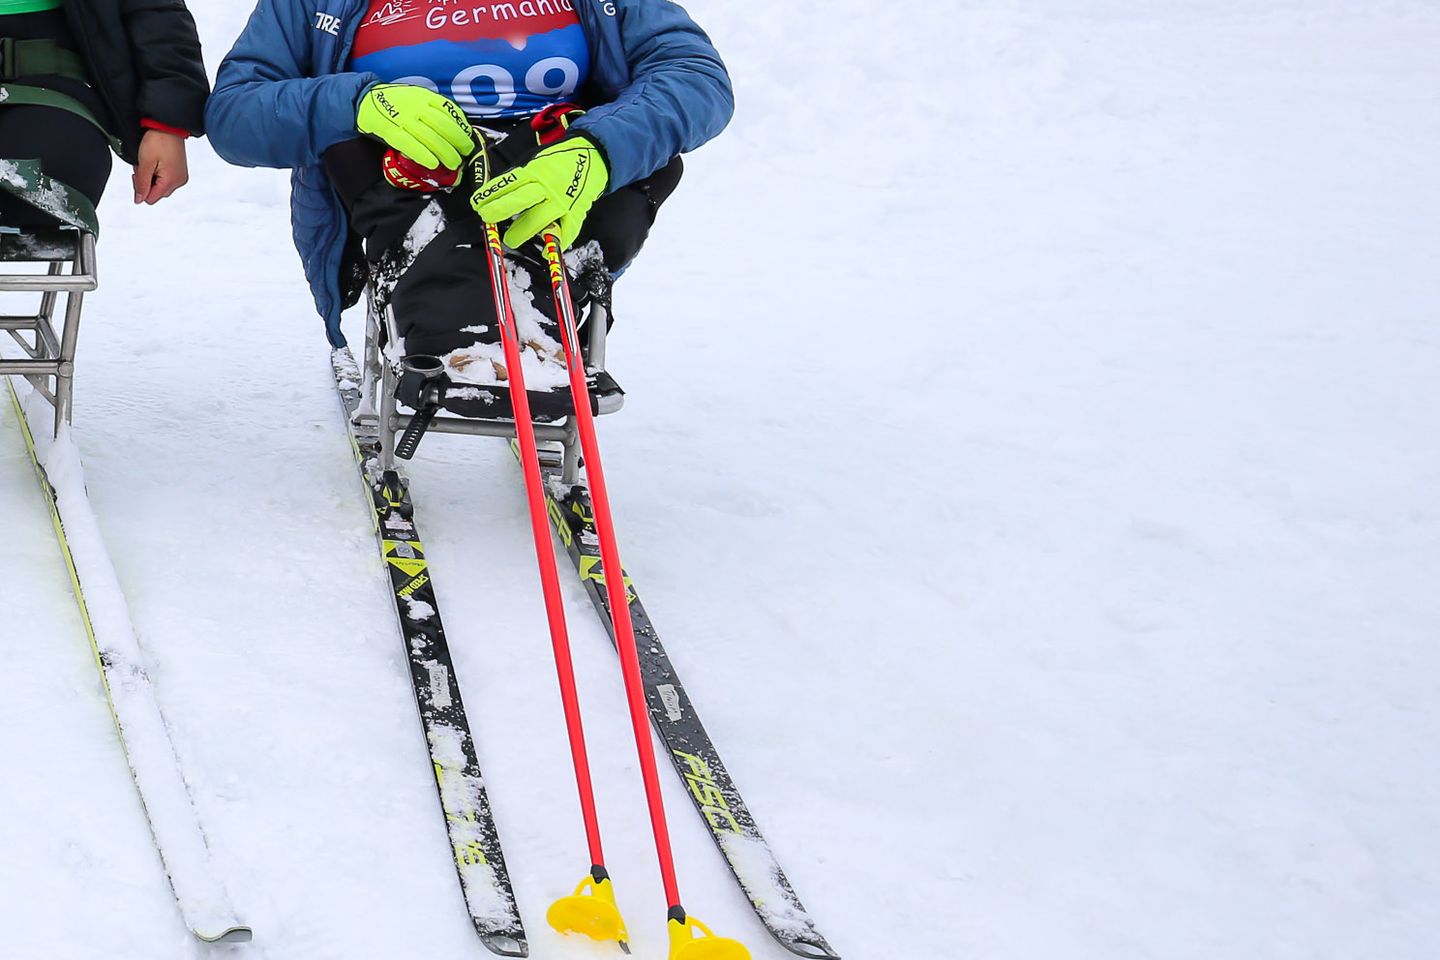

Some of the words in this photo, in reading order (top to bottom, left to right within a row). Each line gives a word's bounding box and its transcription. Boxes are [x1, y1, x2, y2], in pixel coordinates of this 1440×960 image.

[389, 56, 579, 115] 09
[383, 156, 421, 189] LEKI
[474, 161, 483, 183] LEKI
[672, 749, 742, 838] FISC
